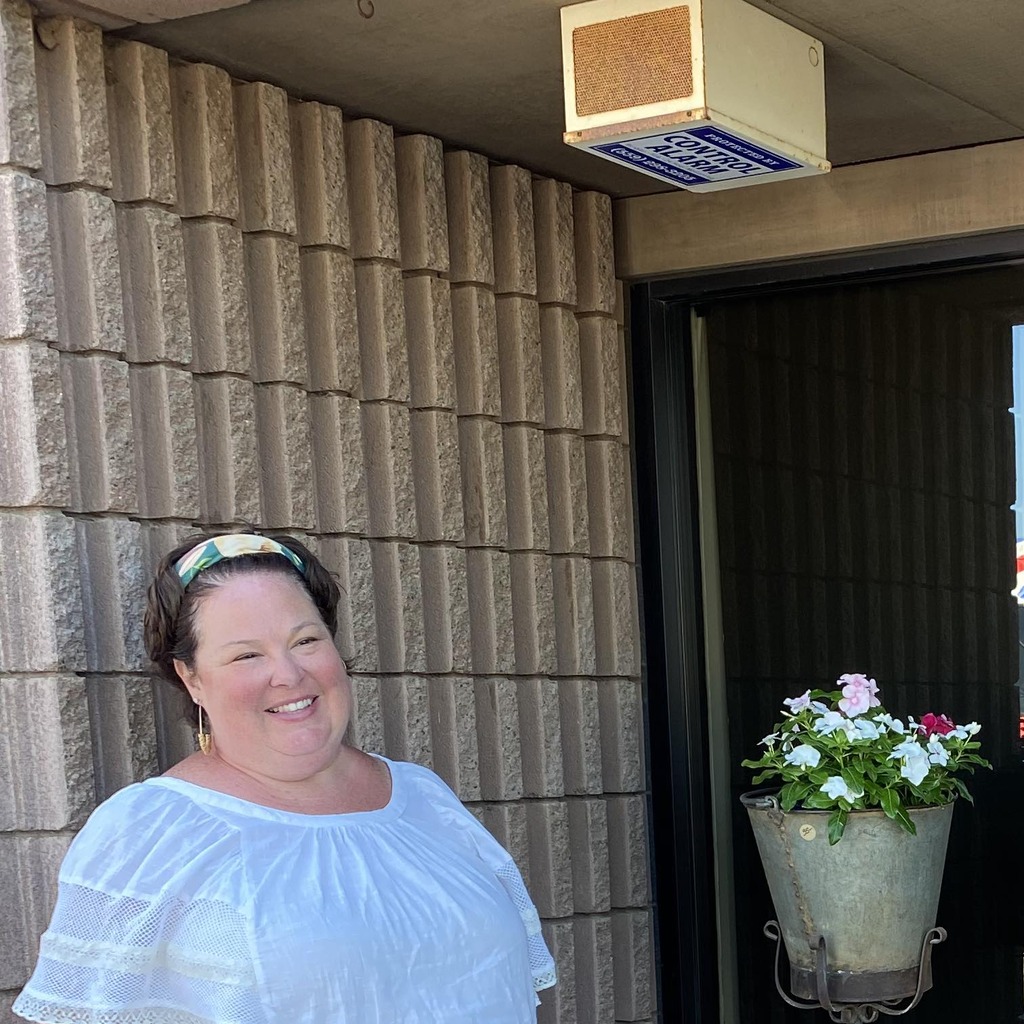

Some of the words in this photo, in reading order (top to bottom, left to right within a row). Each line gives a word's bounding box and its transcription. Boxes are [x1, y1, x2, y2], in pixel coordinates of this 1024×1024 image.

[645, 144, 728, 175] ALARM
[664, 133, 762, 175] CONTROL
[704, 133, 764, 160] PROTECTED
